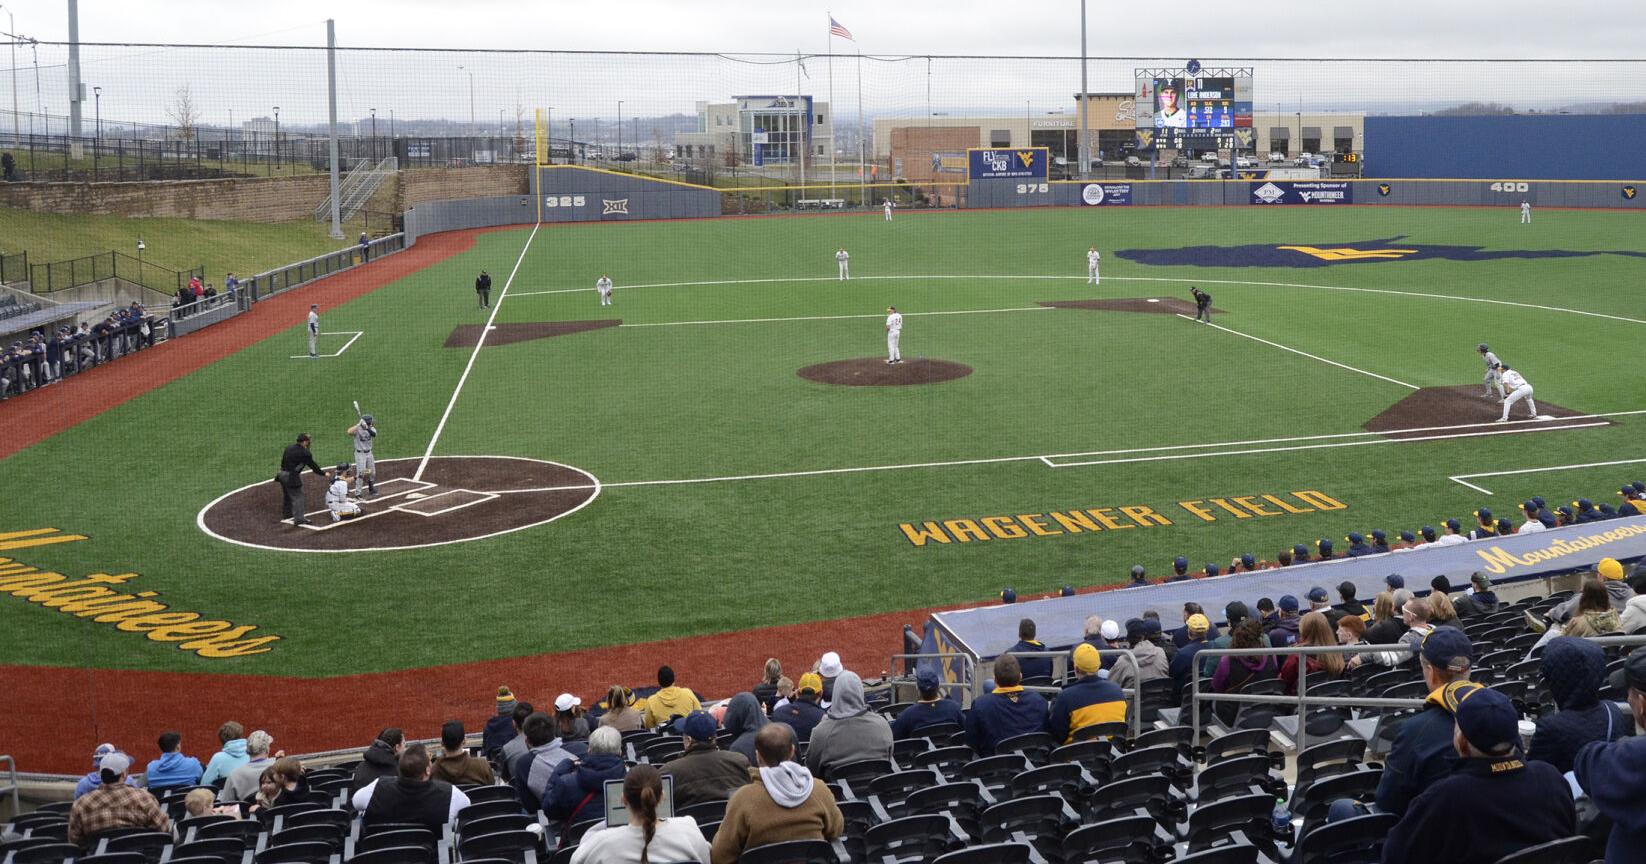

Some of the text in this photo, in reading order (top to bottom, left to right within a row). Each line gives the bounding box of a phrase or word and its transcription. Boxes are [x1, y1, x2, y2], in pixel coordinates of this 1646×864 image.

[983, 151, 997, 162] FLY
[992, 160, 1007, 171] CKB
[1017, 184, 1049, 194] 375
[1490, 183, 1528, 193] 400
[546, 196, 585, 208] 325
[899, 490, 1348, 546] WAGENER FIELD
